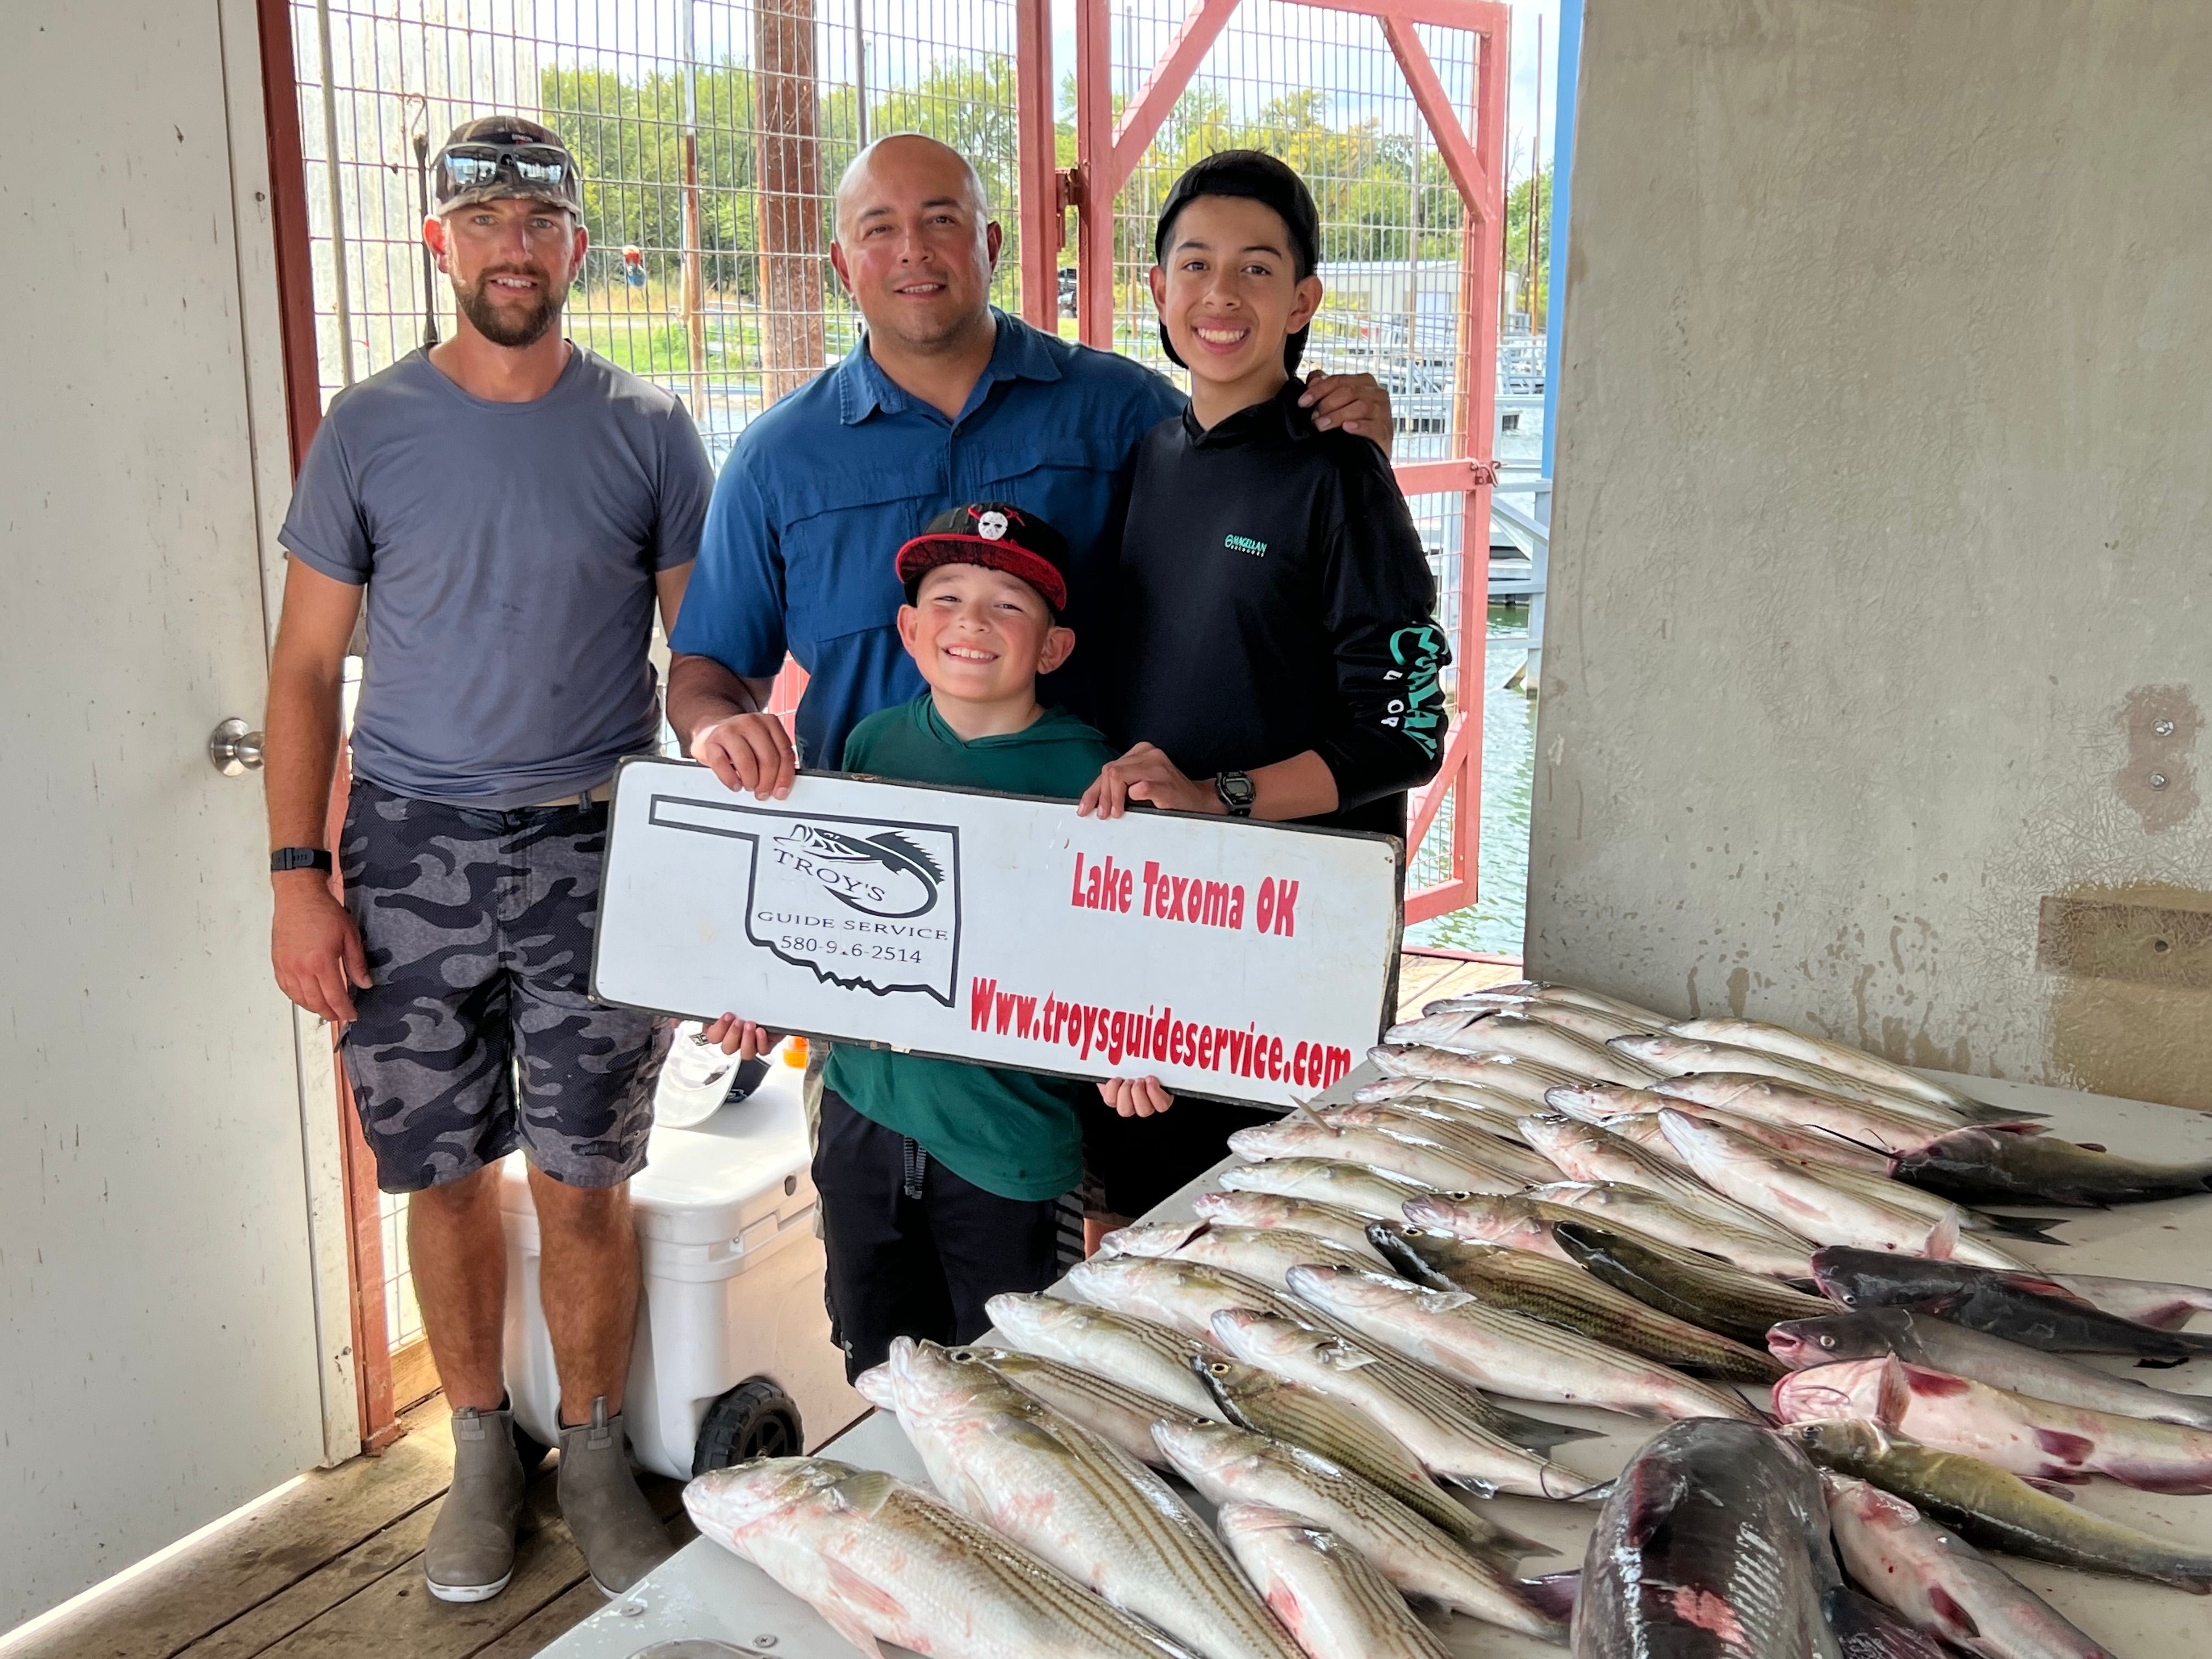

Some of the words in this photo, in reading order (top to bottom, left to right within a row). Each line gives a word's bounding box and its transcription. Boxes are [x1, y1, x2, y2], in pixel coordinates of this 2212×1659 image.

[774, 848, 885, 902] TROY'S
[1071, 851, 1133, 914] Lake
[1143, 860, 1245, 930] Texoma
[1256, 876, 1300, 938] OK
[758, 911, 834, 929] GUIDE
[843, 919, 949, 941] SERVICE
[780, 935, 922, 964] 580-96-2514
